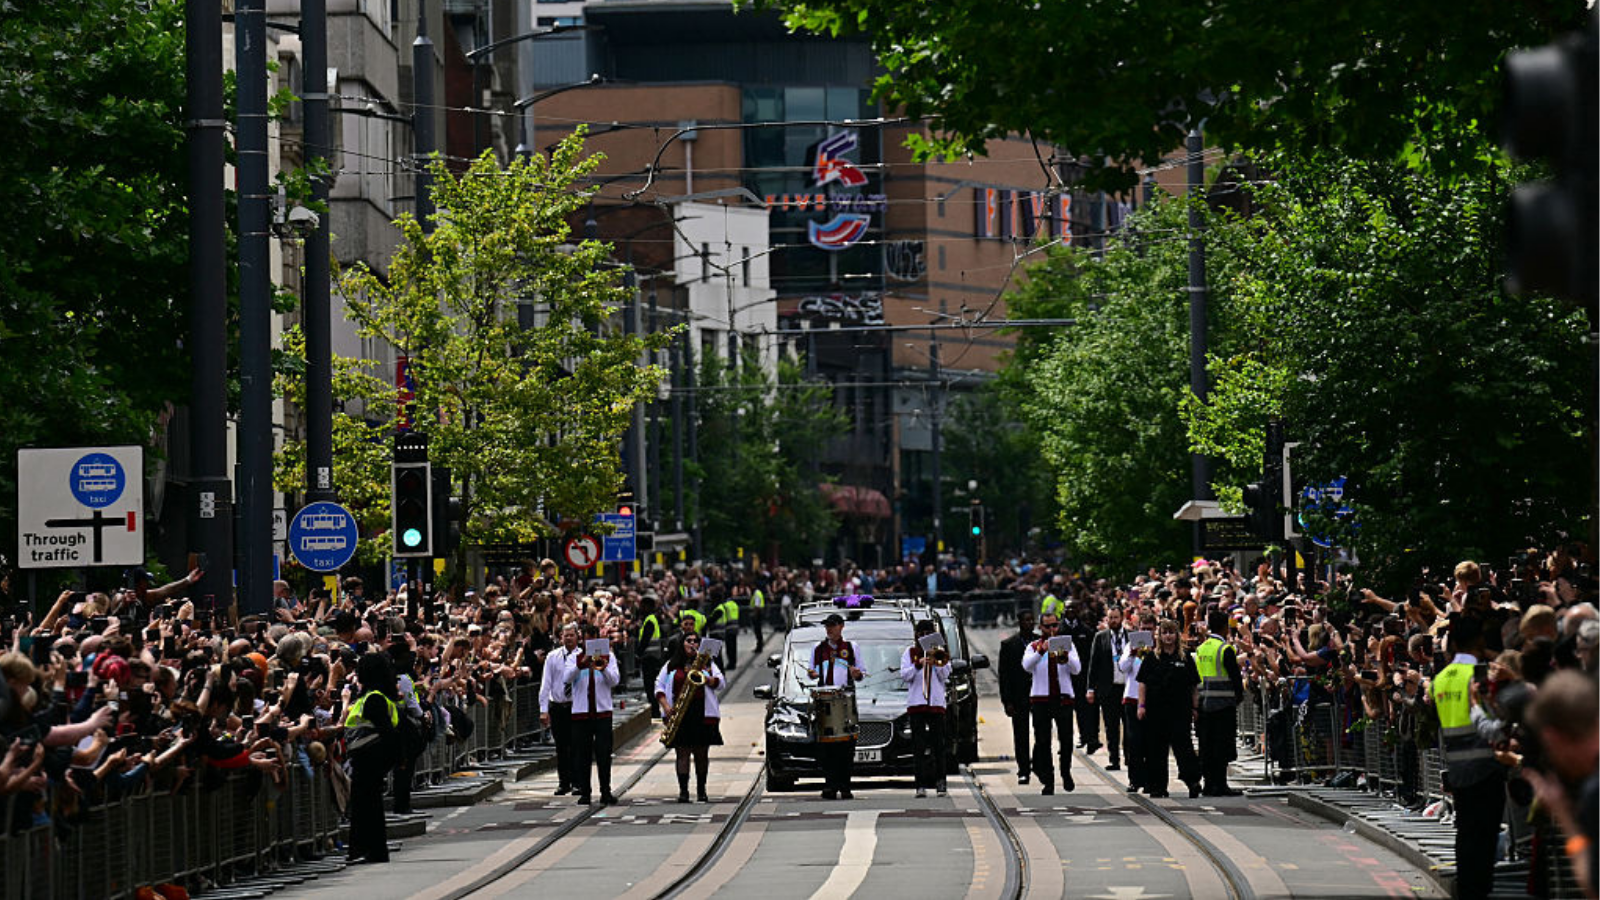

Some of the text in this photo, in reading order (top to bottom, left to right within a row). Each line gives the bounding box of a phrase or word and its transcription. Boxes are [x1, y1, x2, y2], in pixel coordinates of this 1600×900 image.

[23, 532, 87, 547] Through
[31, 548, 79, 561] traffic
[313, 557, 335, 567] taxi
